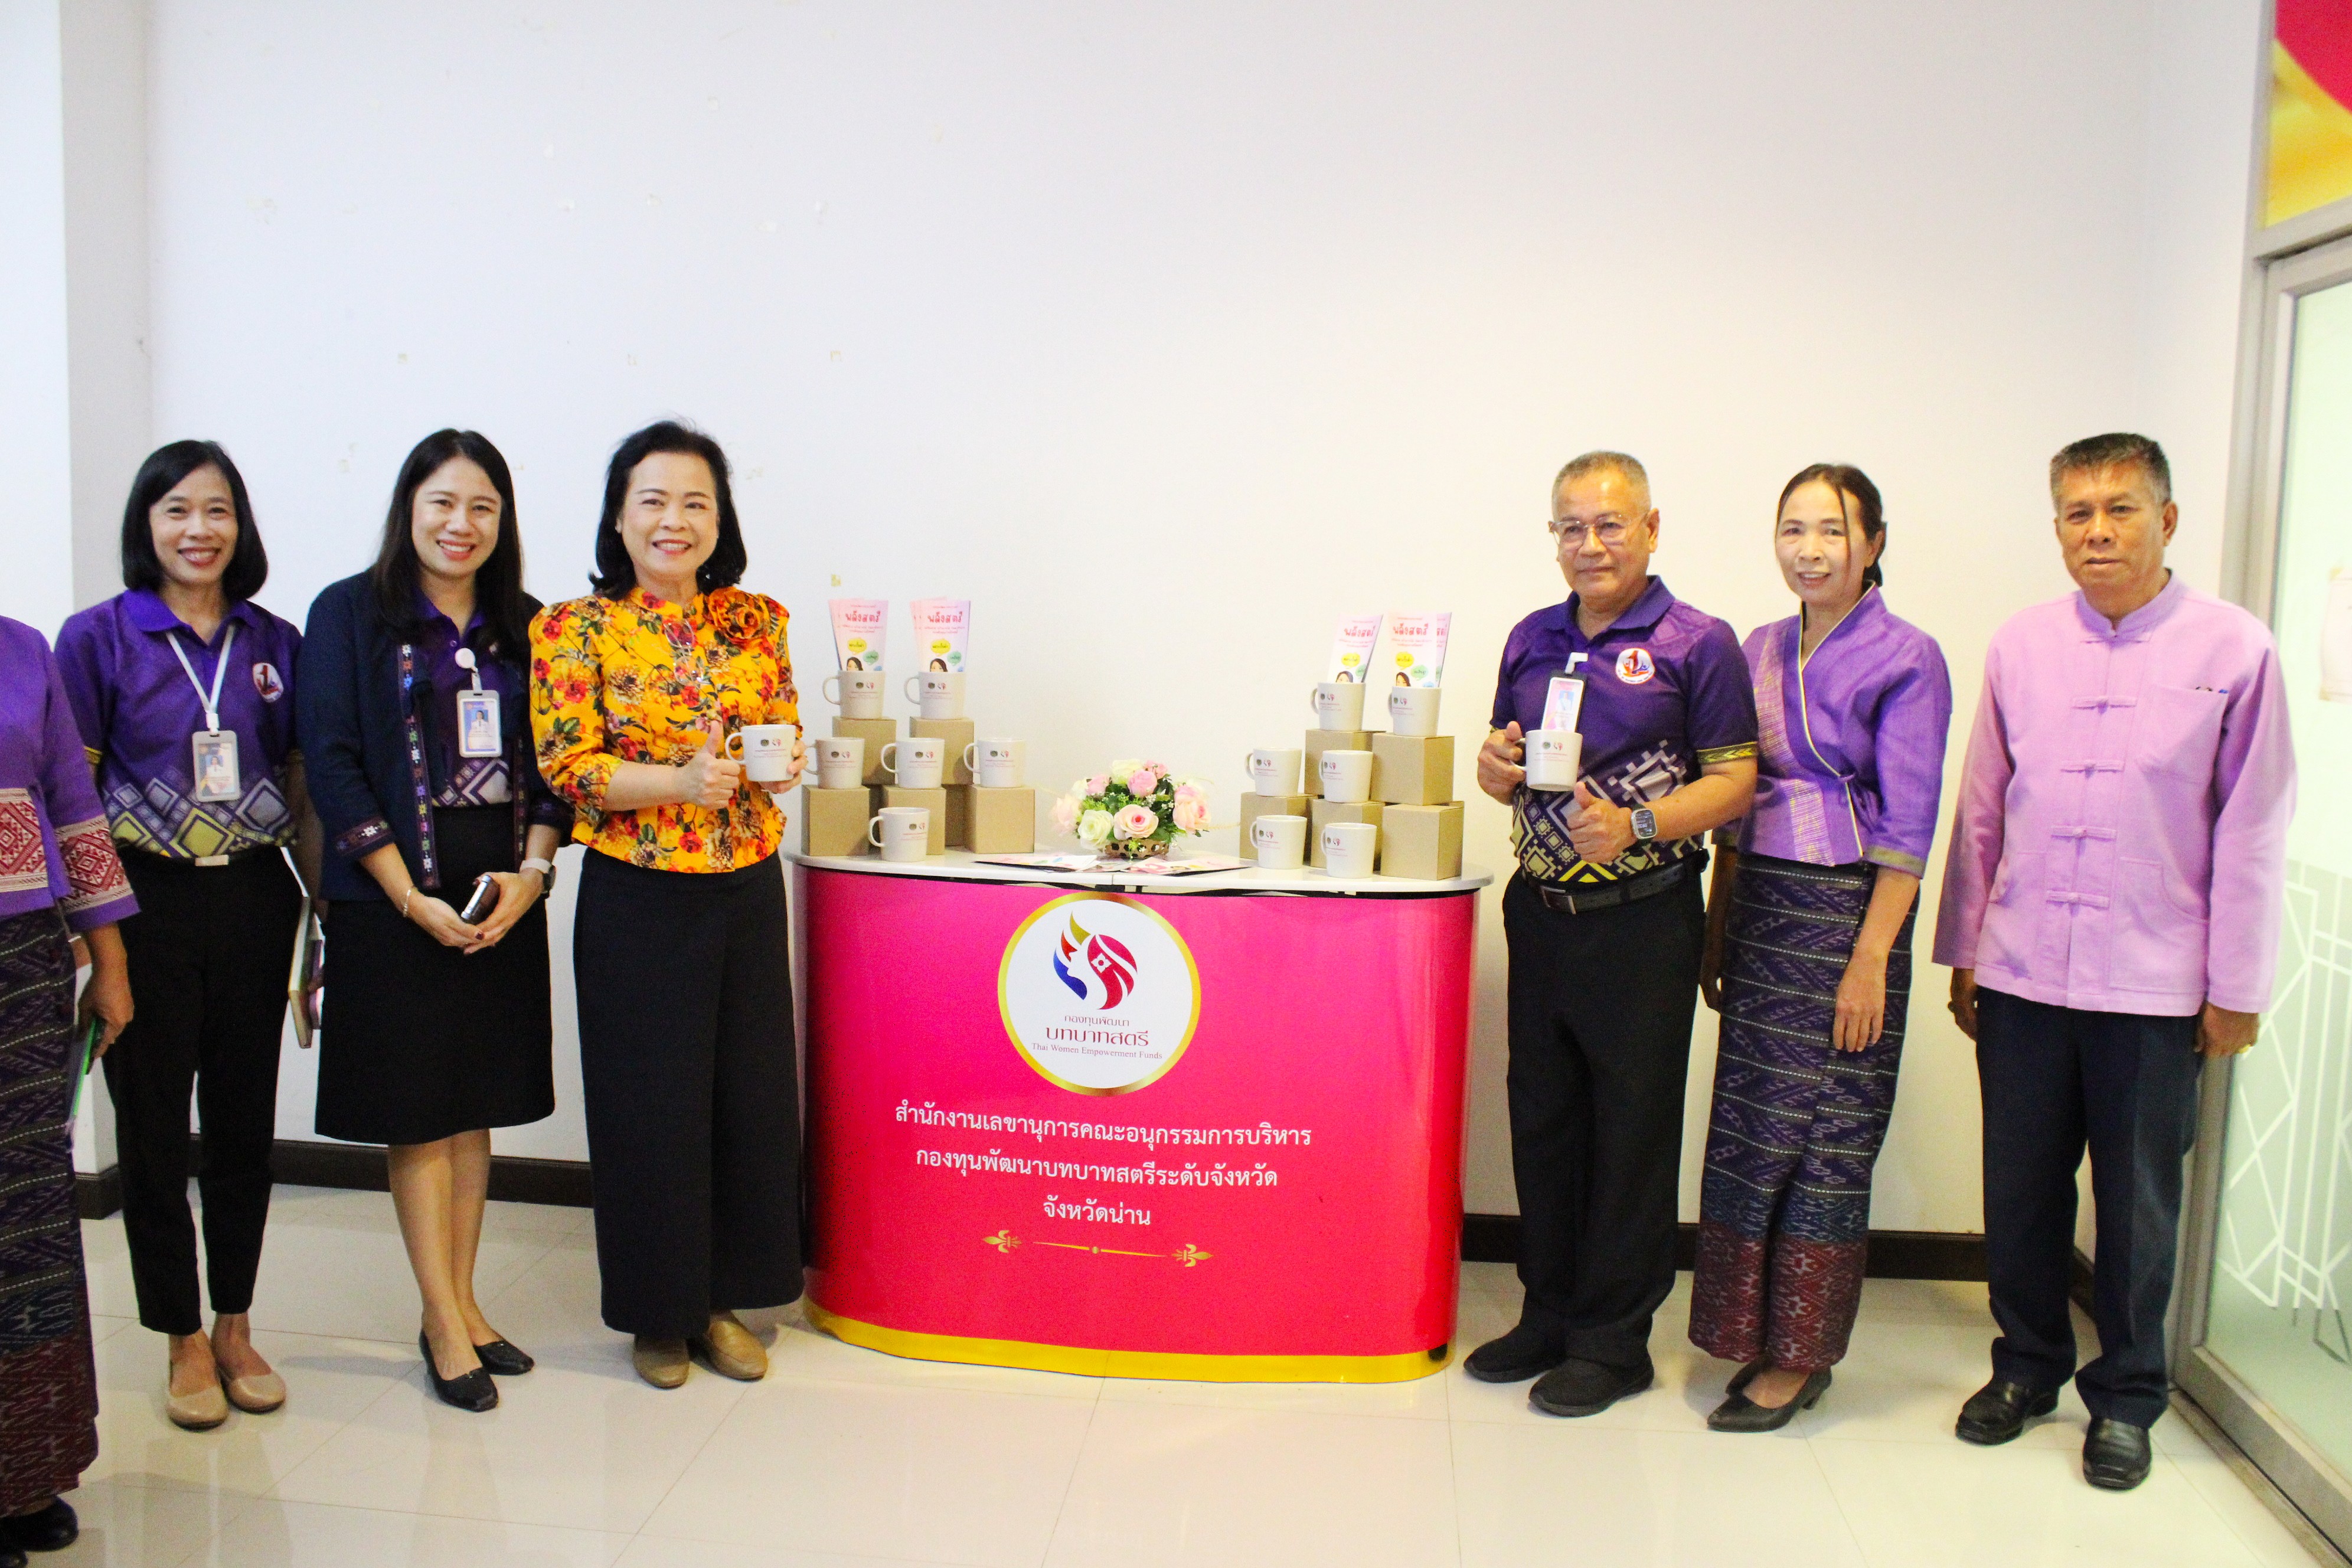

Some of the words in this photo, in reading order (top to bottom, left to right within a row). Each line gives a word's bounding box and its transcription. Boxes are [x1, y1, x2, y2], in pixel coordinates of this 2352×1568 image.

[1064, 1014, 1129, 1027] กองทุนพัฒนา
[1045, 1026, 1149, 1047] บทบาทสตรี
[1031, 1043, 1048, 1051] Thai
[1050, 1044, 1079, 1054] Women
[1081, 1047, 1137, 1058] Empowerment
[1139, 1051, 1162, 1060] Funds
[894, 1099, 1312, 1151] สำนักงานเลขานุการคณะอนุกรรมการบริหาร
[916, 1146, 1278, 1188] กองทุนพัฒนาบทบาทสตรีระดับจังหวัด
[1043, 1194, 1151, 1226] จังหวัดน่าน
